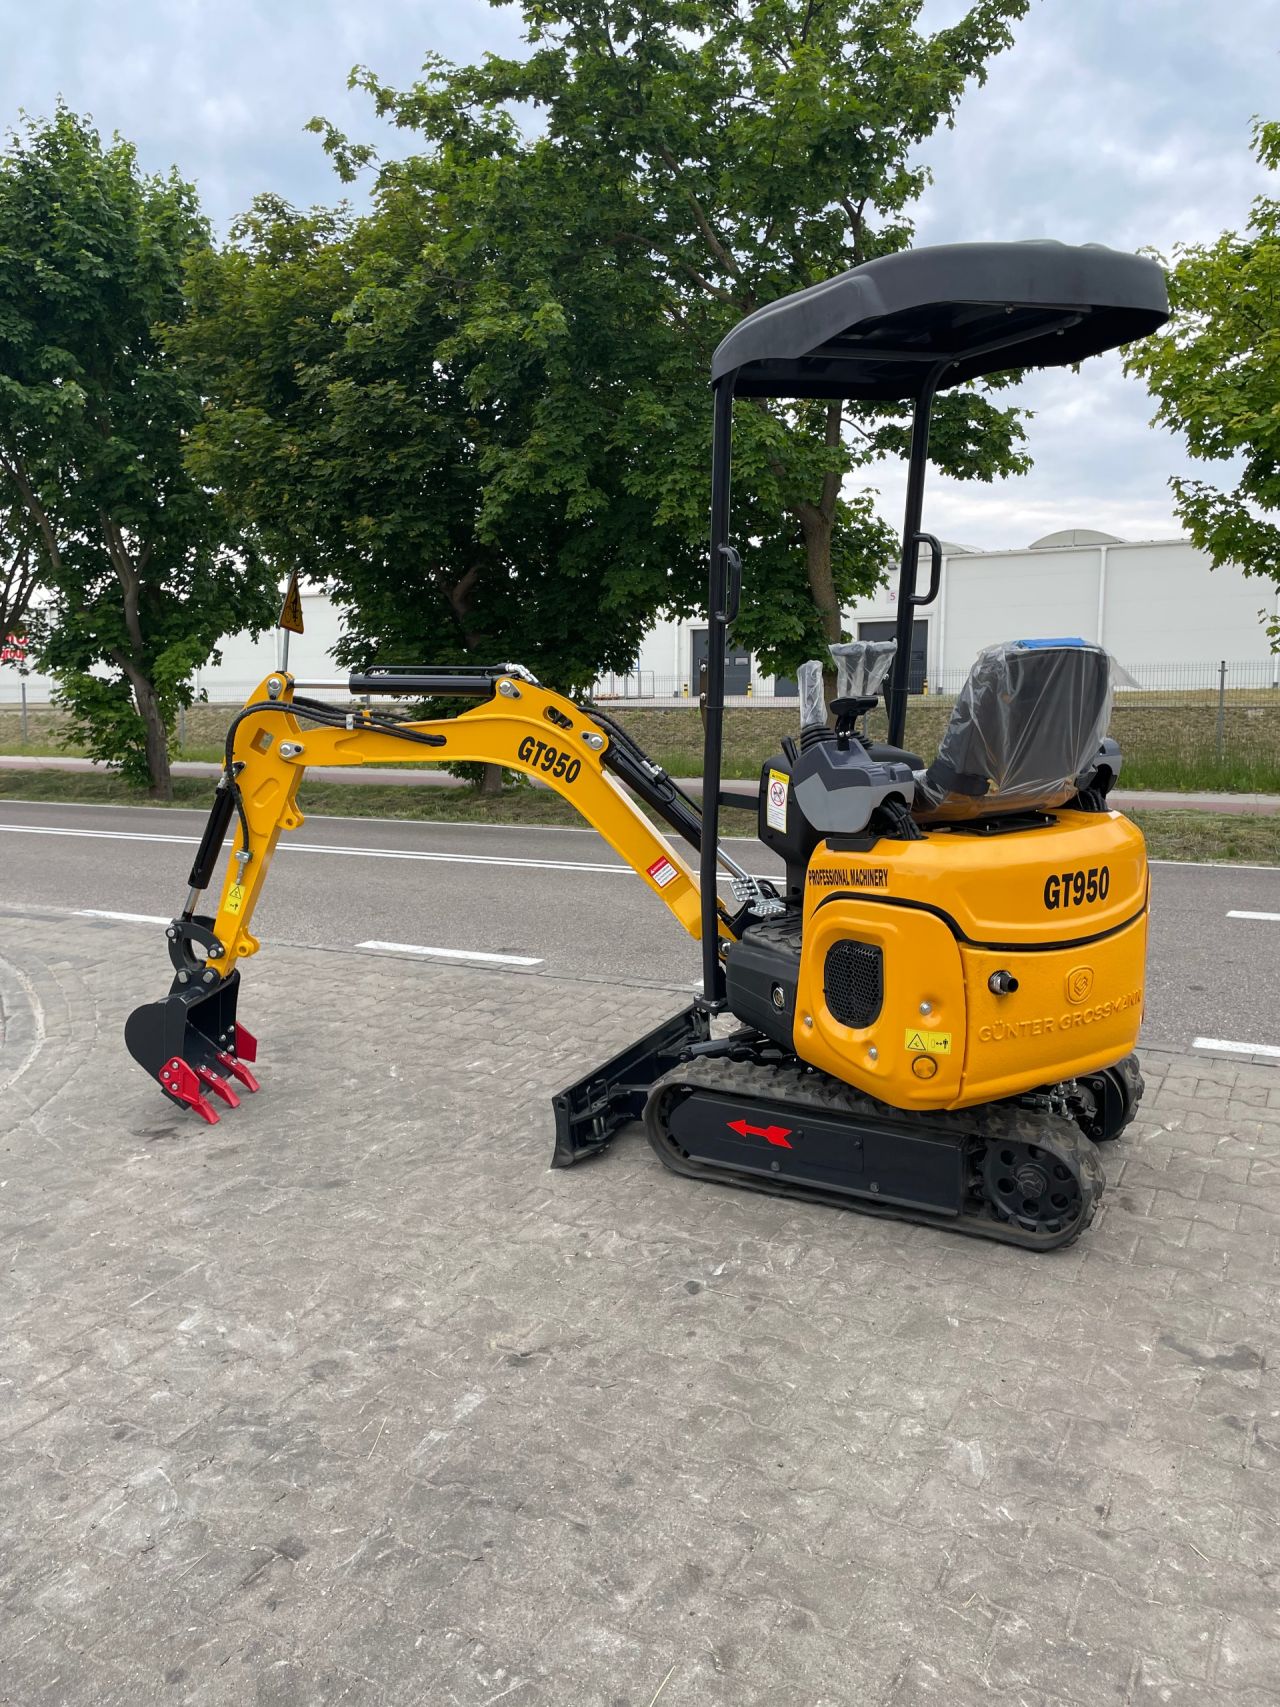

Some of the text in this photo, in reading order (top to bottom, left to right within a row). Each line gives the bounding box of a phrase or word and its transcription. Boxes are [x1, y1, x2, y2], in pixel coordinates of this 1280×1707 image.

[890, 592, 896, 601] 5
[518, 736, 582, 784] GT950
[808, 868, 888, 887] PROFESSIONAL MACHINERY
[1044, 866, 1109, 910] GT950
[978, 989, 1142, 1042] GÜNTER GROSSMANN
